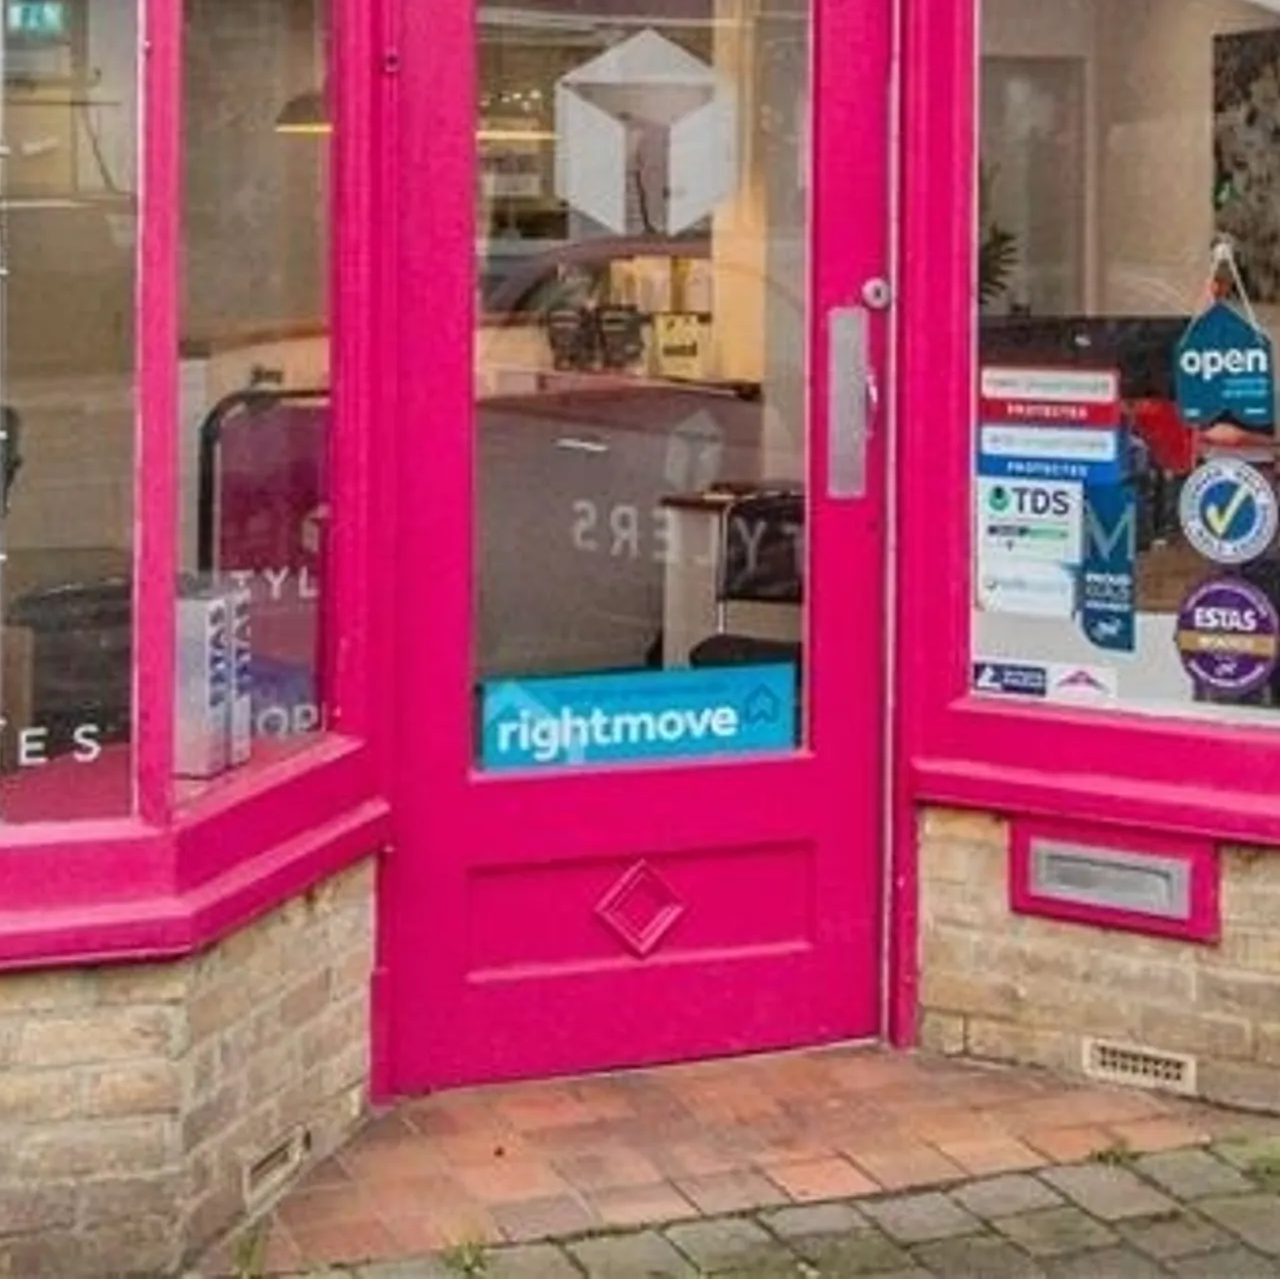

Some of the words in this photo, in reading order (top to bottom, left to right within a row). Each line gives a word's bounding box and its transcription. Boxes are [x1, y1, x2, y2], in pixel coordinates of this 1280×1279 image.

[1180, 347, 1268, 382] open
[1011, 487, 1070, 515] TDS
[1194, 607, 1258, 632] ESTAS
[497, 703, 739, 762] rightmove
